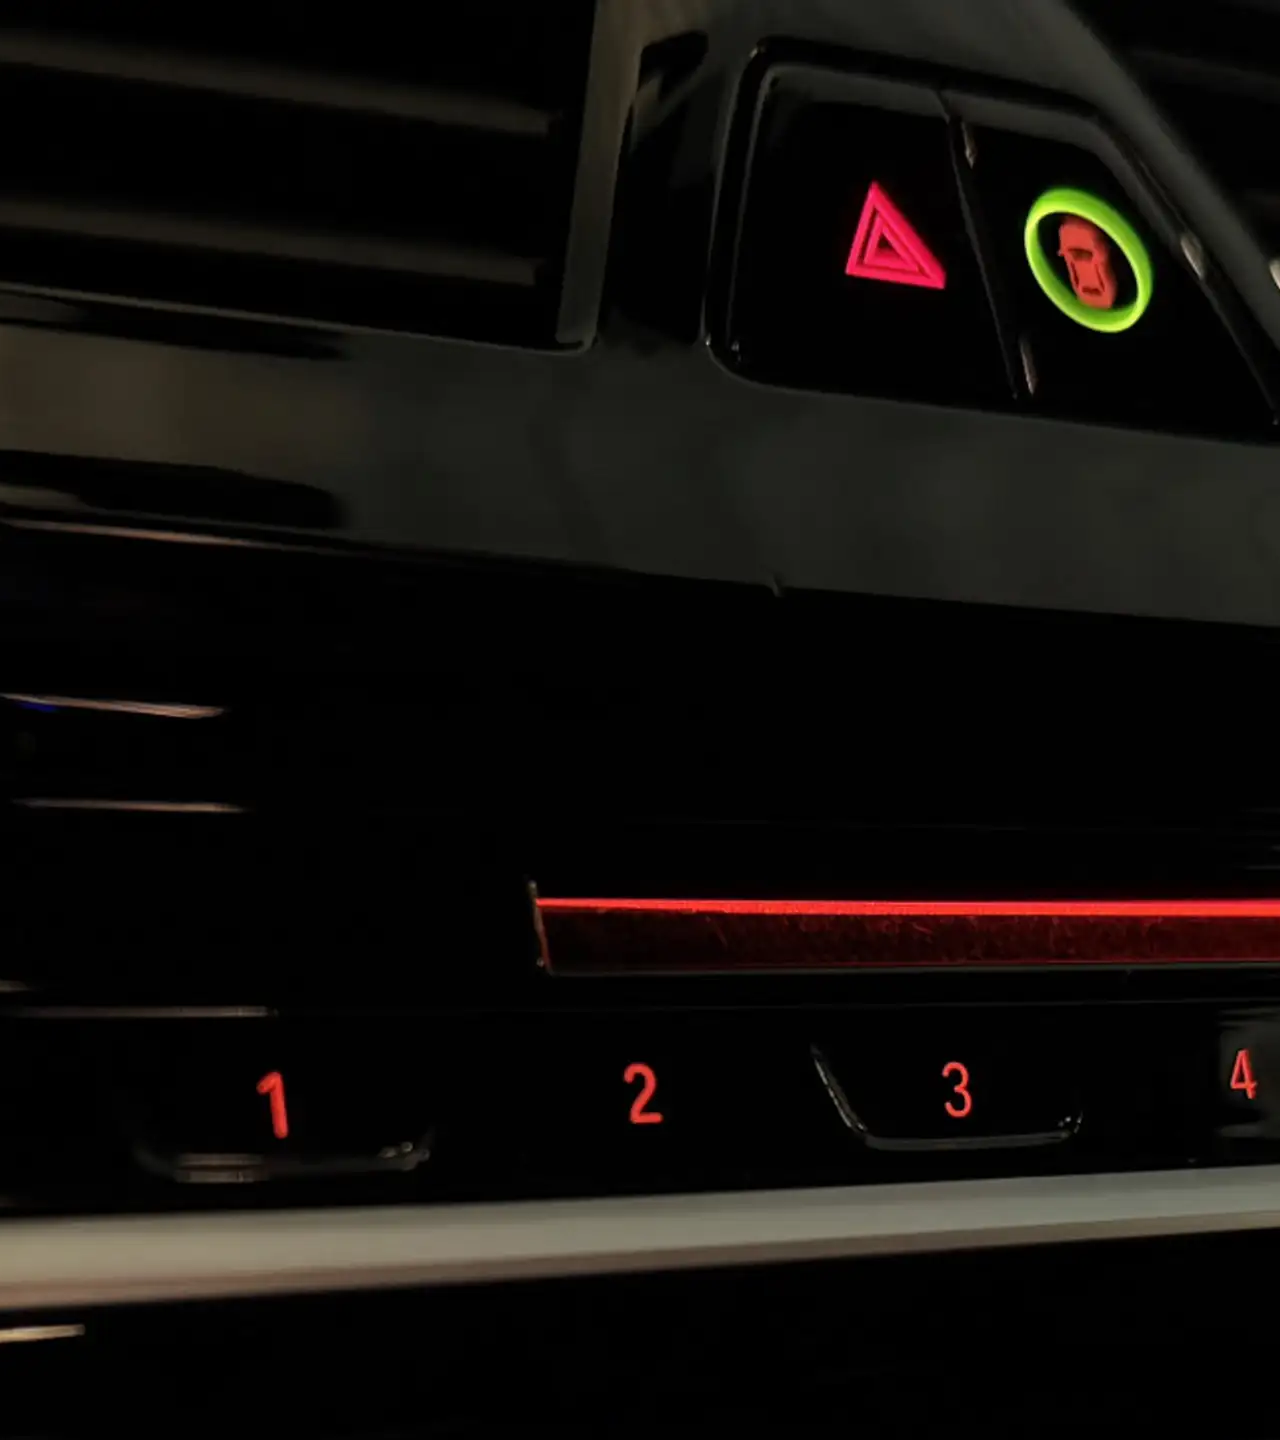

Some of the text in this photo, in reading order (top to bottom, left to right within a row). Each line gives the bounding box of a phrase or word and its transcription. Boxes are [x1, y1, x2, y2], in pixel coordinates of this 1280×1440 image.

[256, 1069, 290, 1140] 1
[622, 1061, 665, 1126] 2
[940, 1060, 974, 1120] 3
[1228, 1047, 1258, 1101] 4
